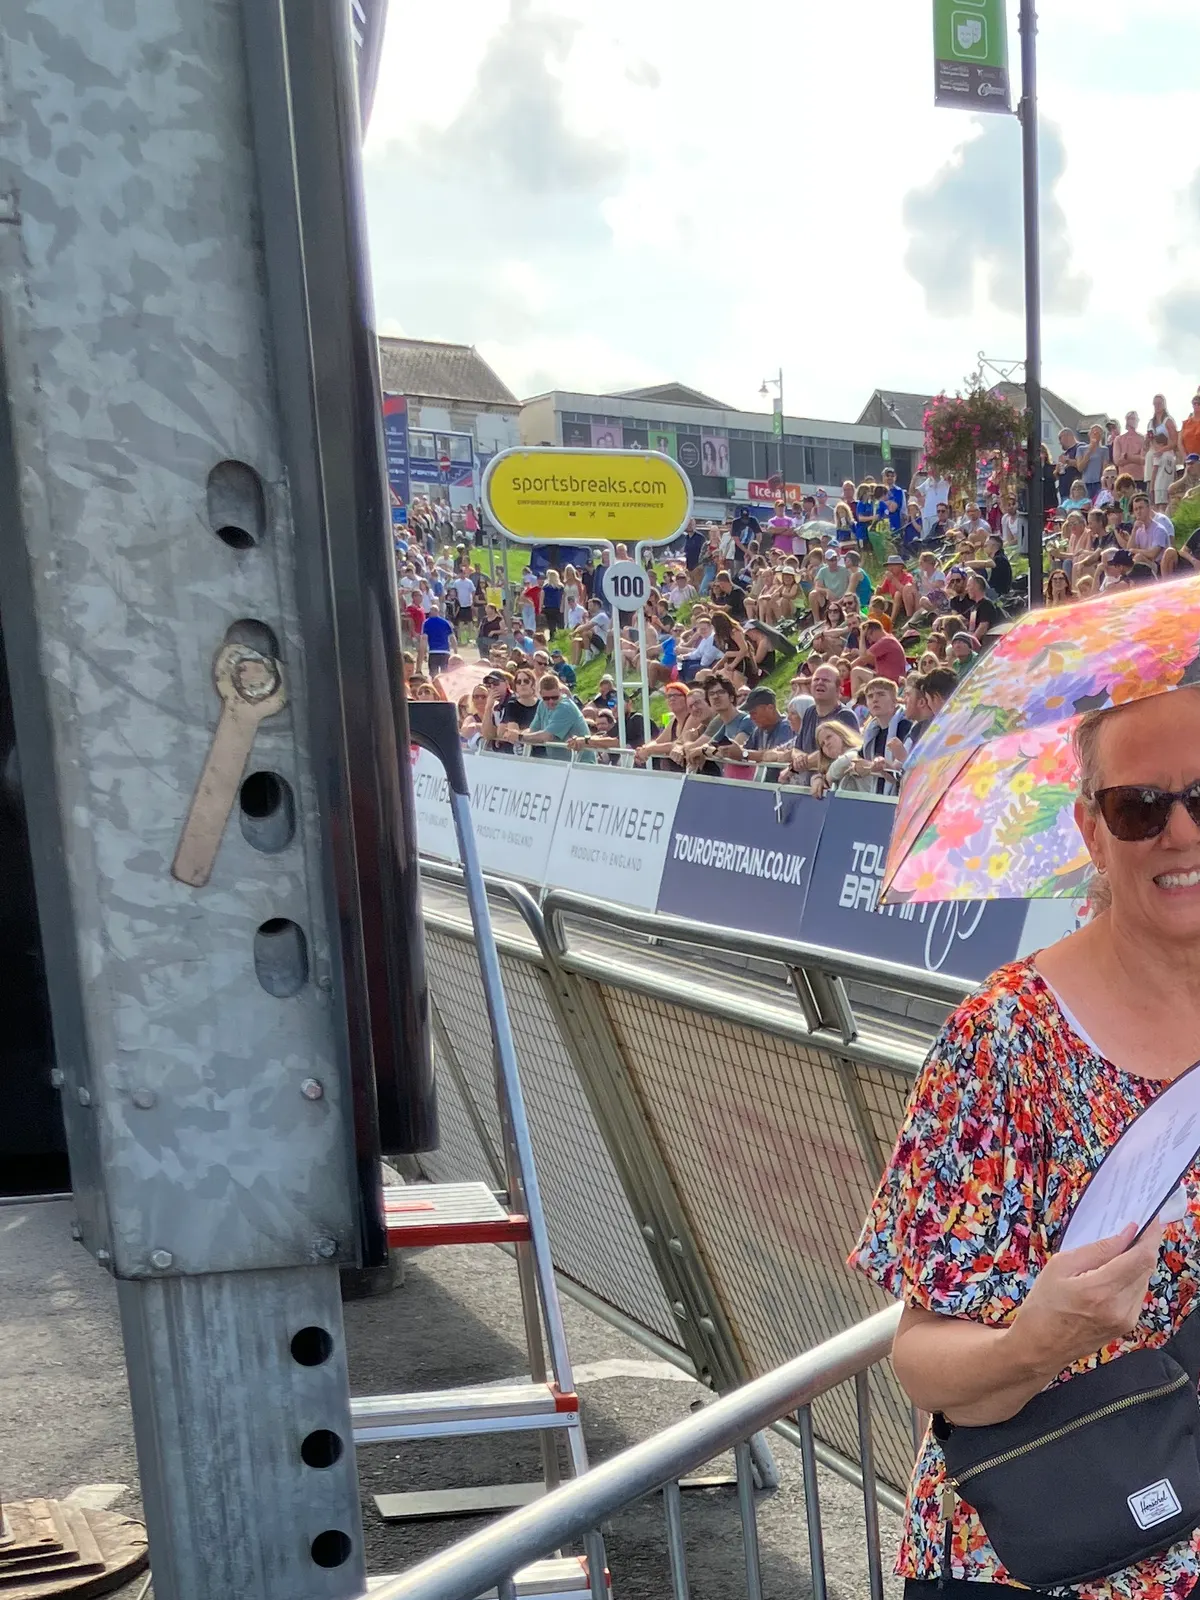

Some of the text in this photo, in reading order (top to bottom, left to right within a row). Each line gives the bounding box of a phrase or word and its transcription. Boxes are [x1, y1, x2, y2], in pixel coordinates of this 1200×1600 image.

[512, 475, 667, 495] sportsbreaks.com
[611, 575, 644, 598] 100
[471, 783, 552, 825] NYETIMBER
[564, 799, 665, 845] NYETIMBER
[673, 832, 807, 886] TOUROFBRITAIN.CO.UK
